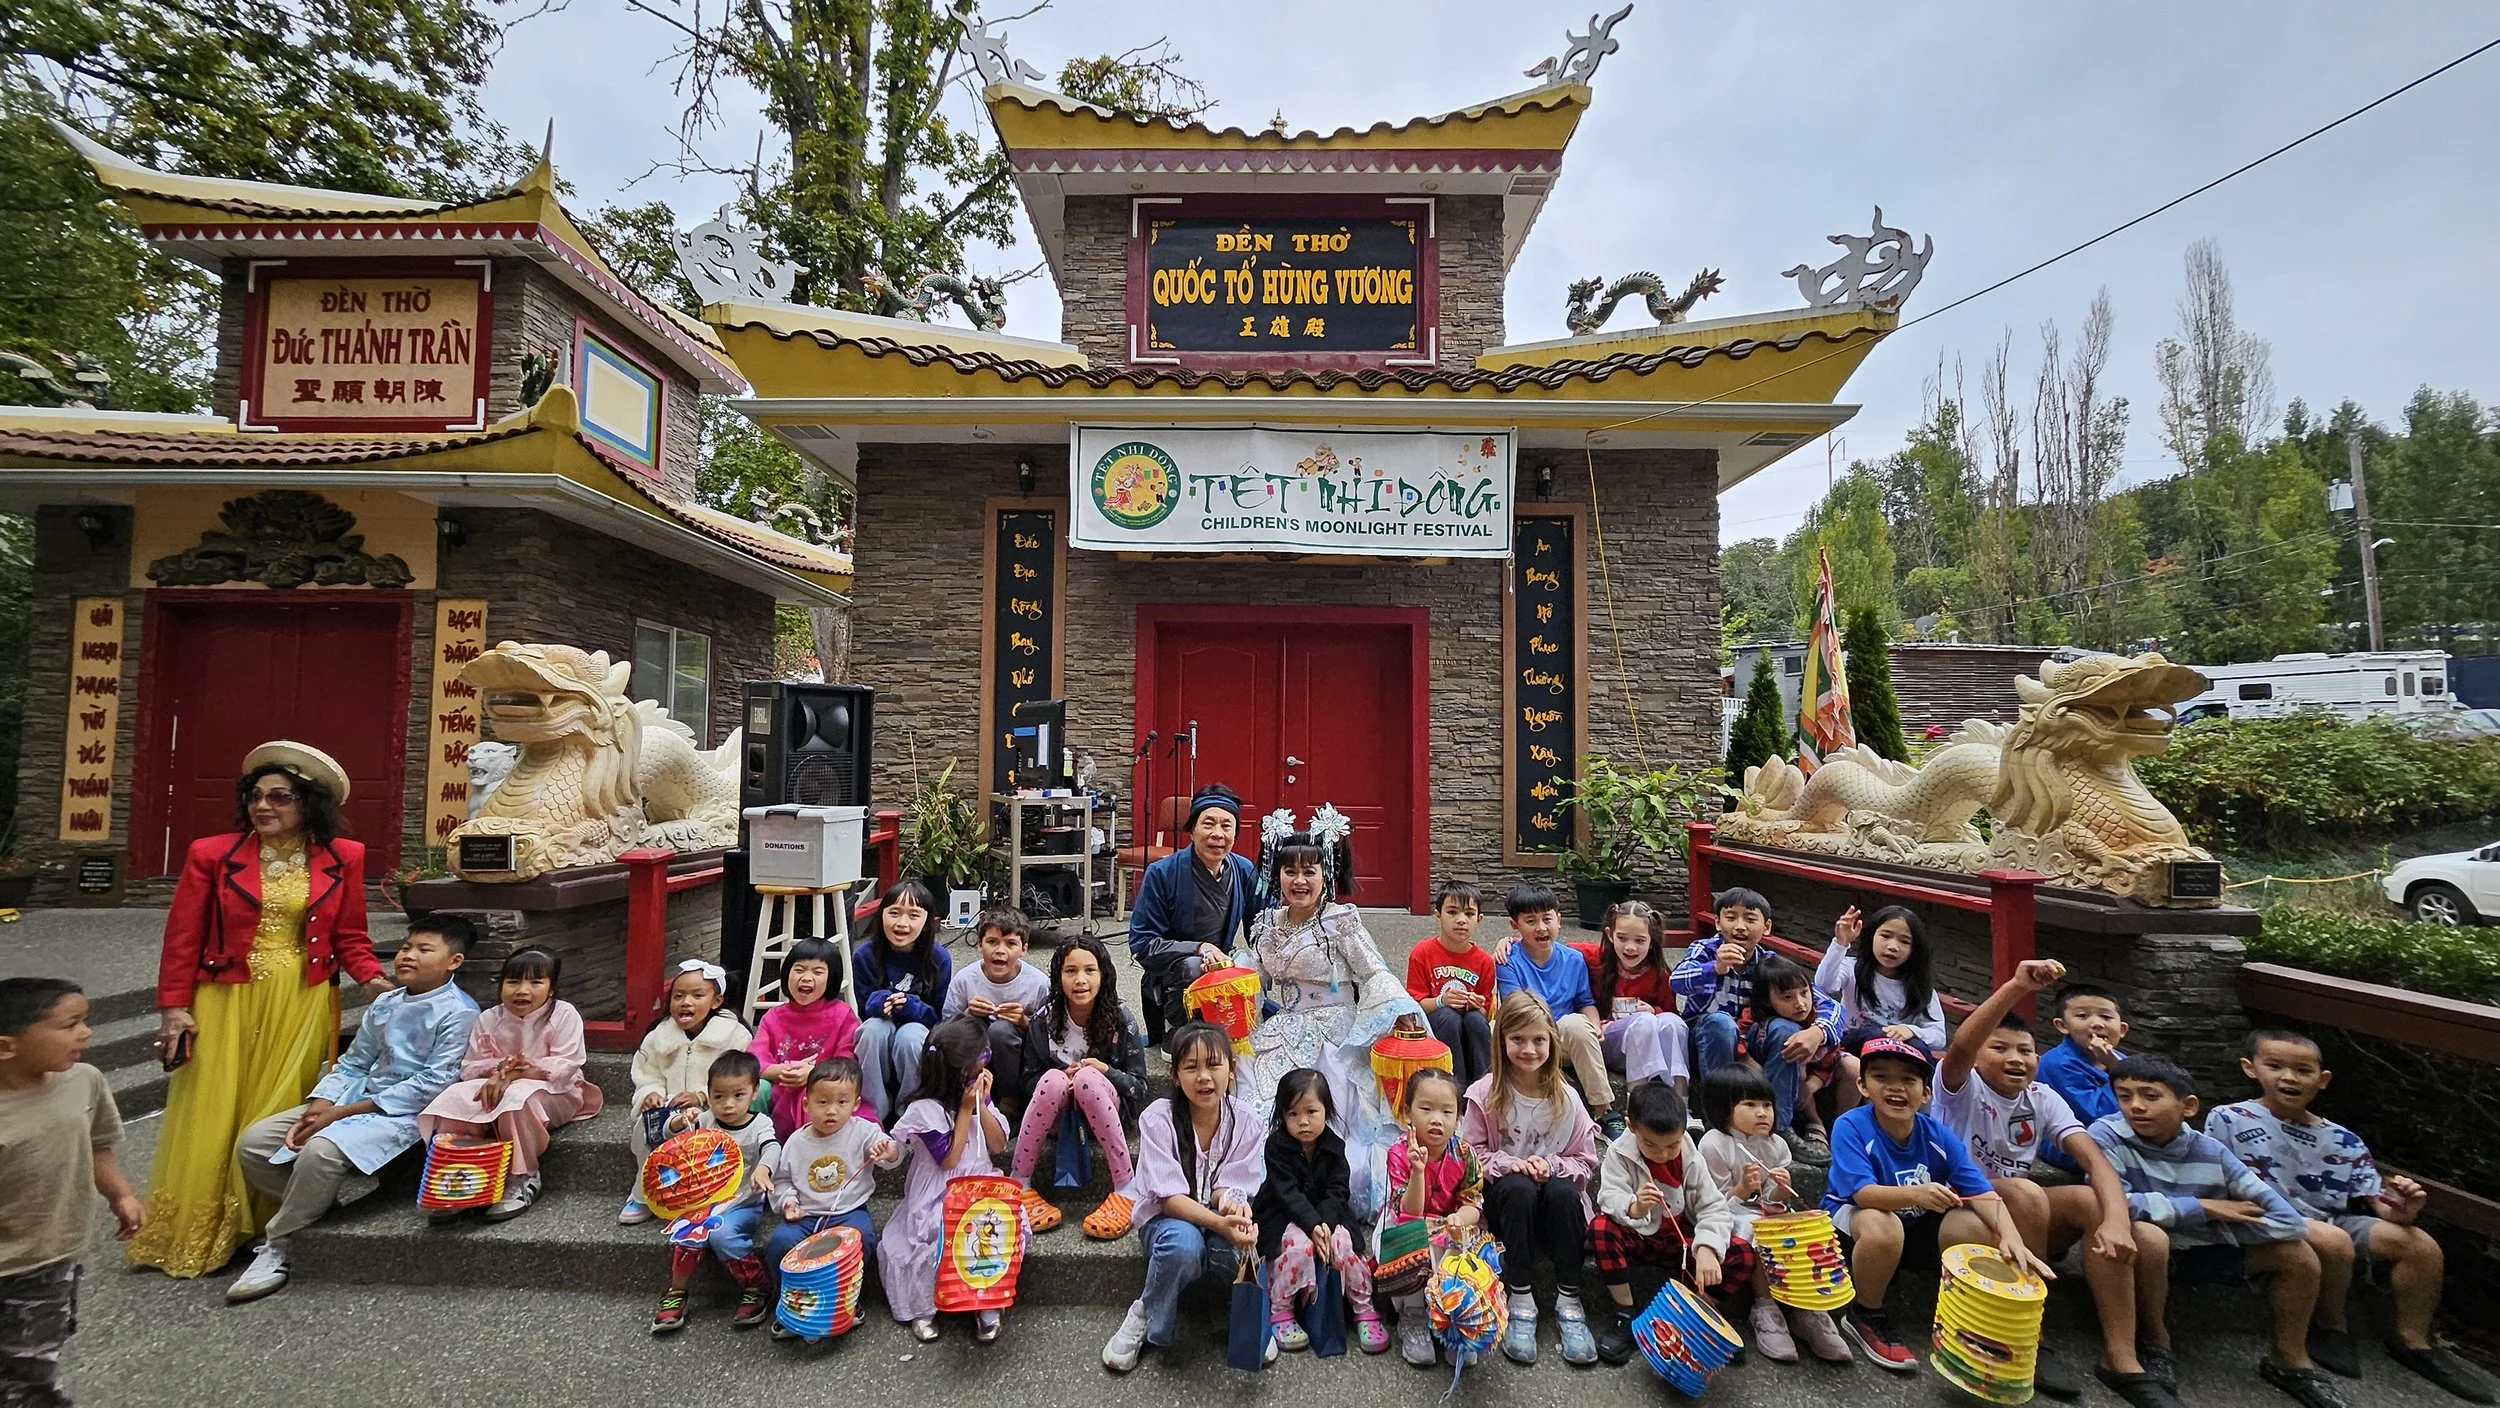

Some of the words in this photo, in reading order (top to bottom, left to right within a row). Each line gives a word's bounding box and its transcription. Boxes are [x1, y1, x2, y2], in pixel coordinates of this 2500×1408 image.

[1153, 256, 1217, 306] QUỐC
[1224, 255, 1256, 304] TỔ
[1262, 262, 1328, 304] HÙNG
[1335, 266, 1413, 304] VƯƠNG
[382, 286, 432, 313] THỜ
[320, 319, 403, 365] THÁNH
[408, 319, 472, 365] TRẦN
[1201, 516, 1300, 531] CHILDREN'S
[1305, 520, 1408, 536] MOONLIGHT
[1413, 523, 1493, 538] FESTIVAL
[448, 609, 482, 632] BẠCH
[439, 706, 476, 734] TIẾNG
[441, 783, 467, 802] ANH
[764, 842, 805, 851] DONATIONS
[1433, 965, 1479, 986] FUTURE
